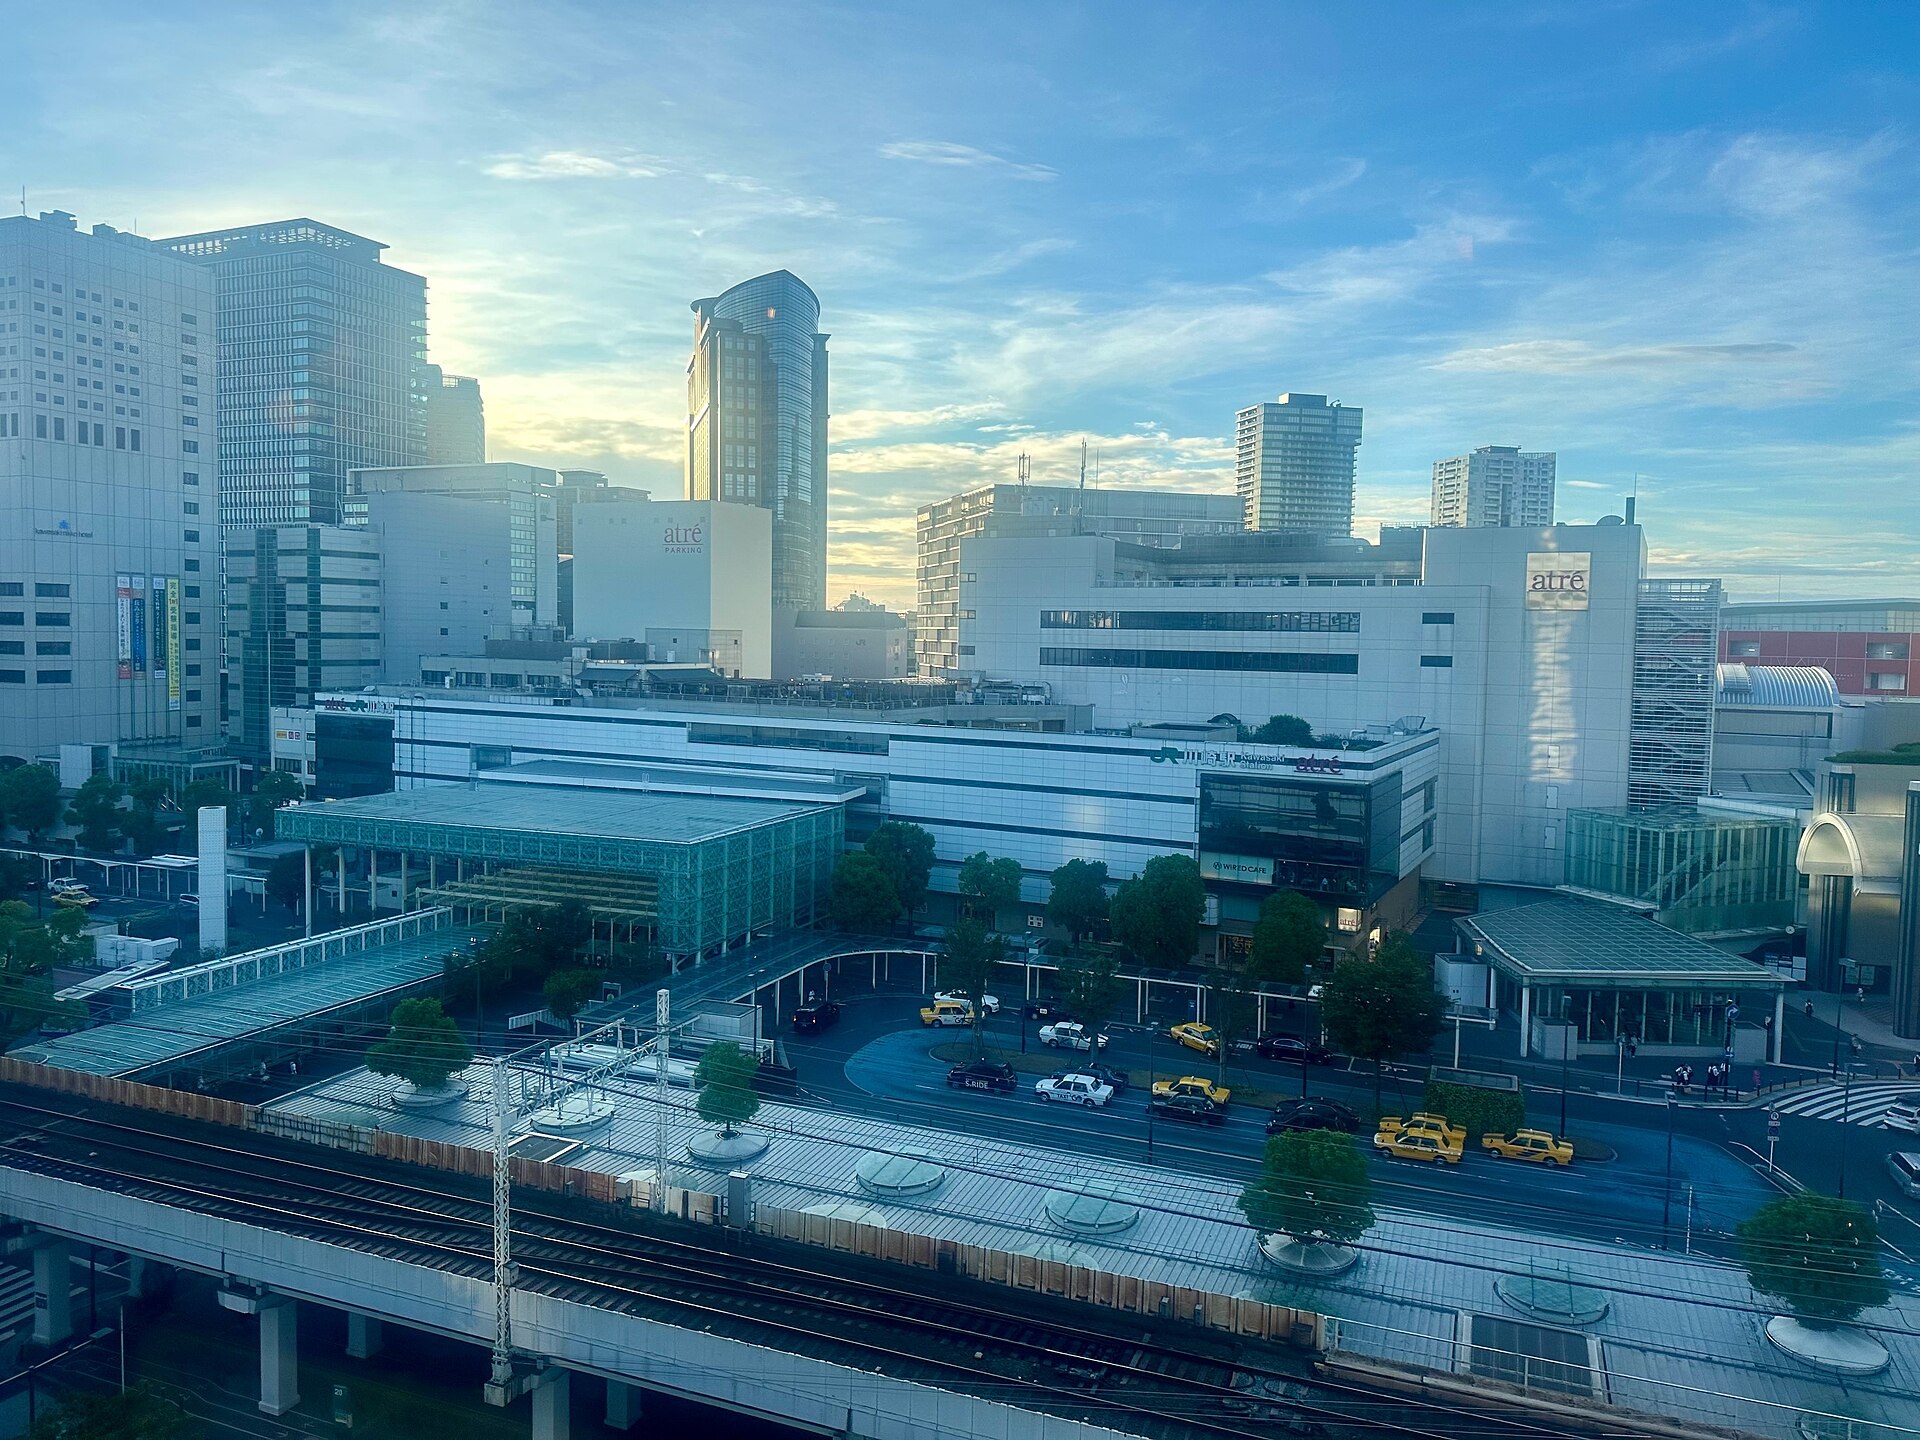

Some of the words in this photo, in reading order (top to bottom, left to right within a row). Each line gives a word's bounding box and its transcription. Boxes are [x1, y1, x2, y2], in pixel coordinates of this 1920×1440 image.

[663, 522, 703, 544] atré
[664, 546, 703, 554] PARKING
[1531, 569, 1586, 592] atré
[325, 696, 347, 711] atré
[350, 699, 366, 712] JR
[1150, 746, 1179, 764] JR
[1183, 748, 1236, 768] 川崎駅
[1240, 751, 1285, 763] Kawasaki
[1239, 760, 1273, 771] Station
[1295, 753, 1341, 774] atré
[1222, 863, 1248, 872] WIRED
[1248, 865, 1267, 874] CAFE
[1339, 917, 1357, 926] atré
[965, 1080, 989, 1089] S.RIDE
